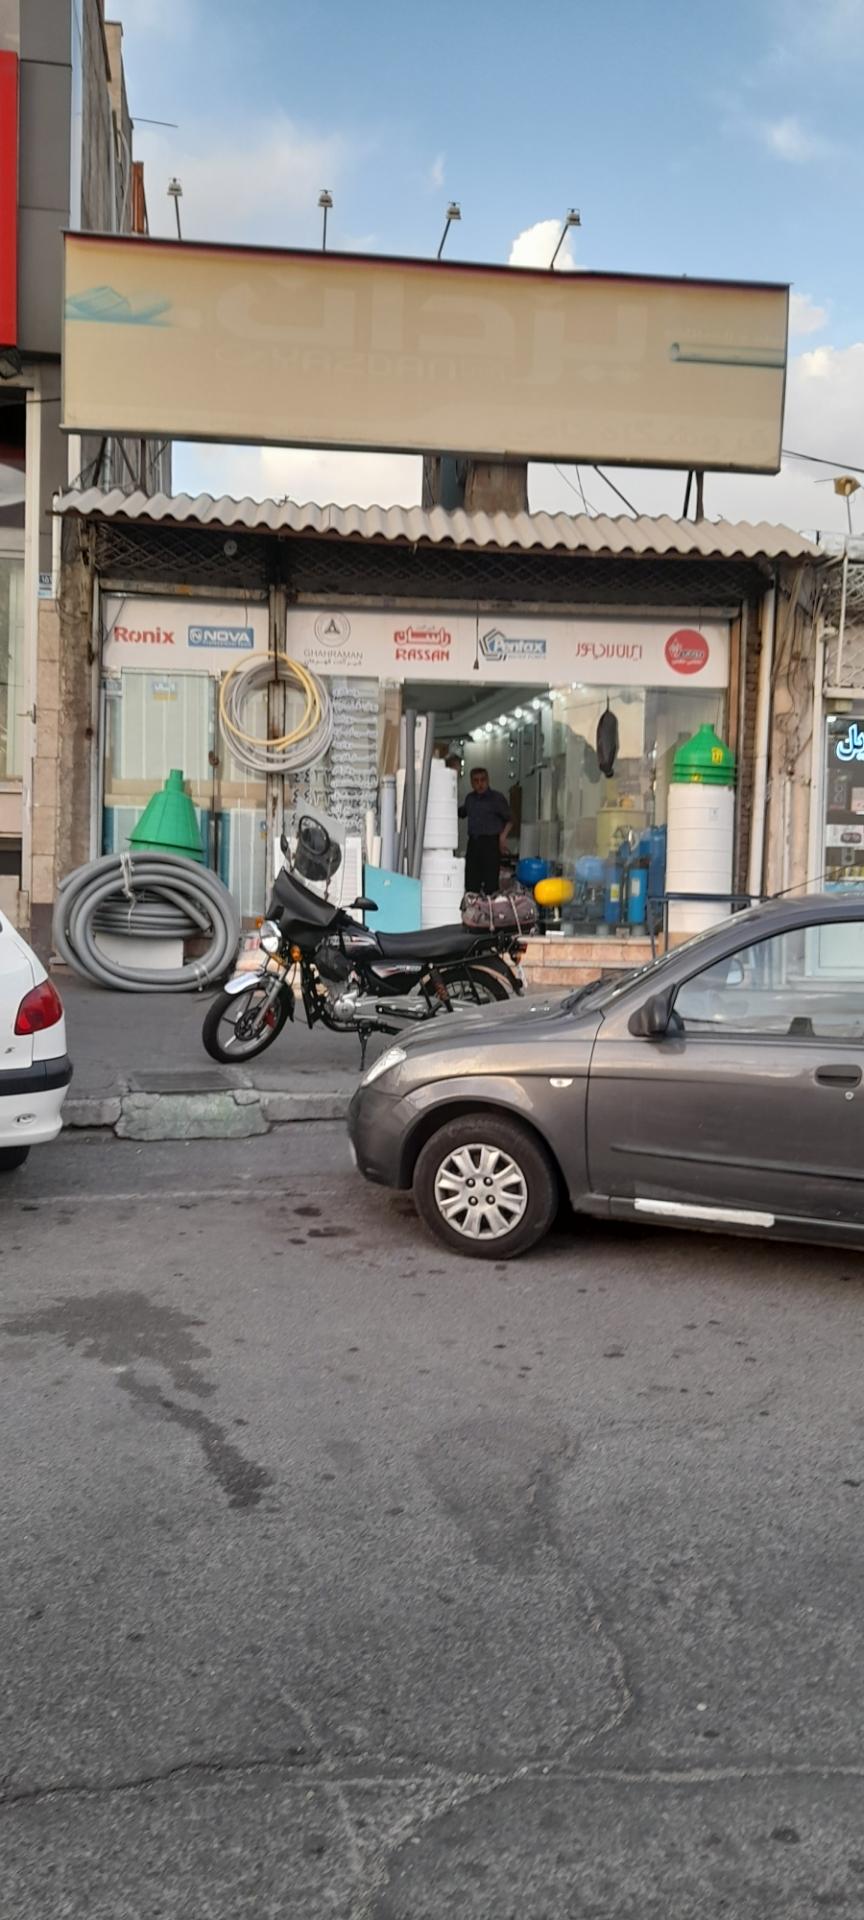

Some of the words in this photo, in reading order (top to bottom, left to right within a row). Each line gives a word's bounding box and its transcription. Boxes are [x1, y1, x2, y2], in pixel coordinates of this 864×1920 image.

[271, 347, 457, 381] YAZDAN
[113, 625, 175, 645] Ronix
[203, 631, 251, 644] NOVA
[303, 648, 364, 660] GHAHRAMAN
[394, 647, 450, 662] RASSAN
